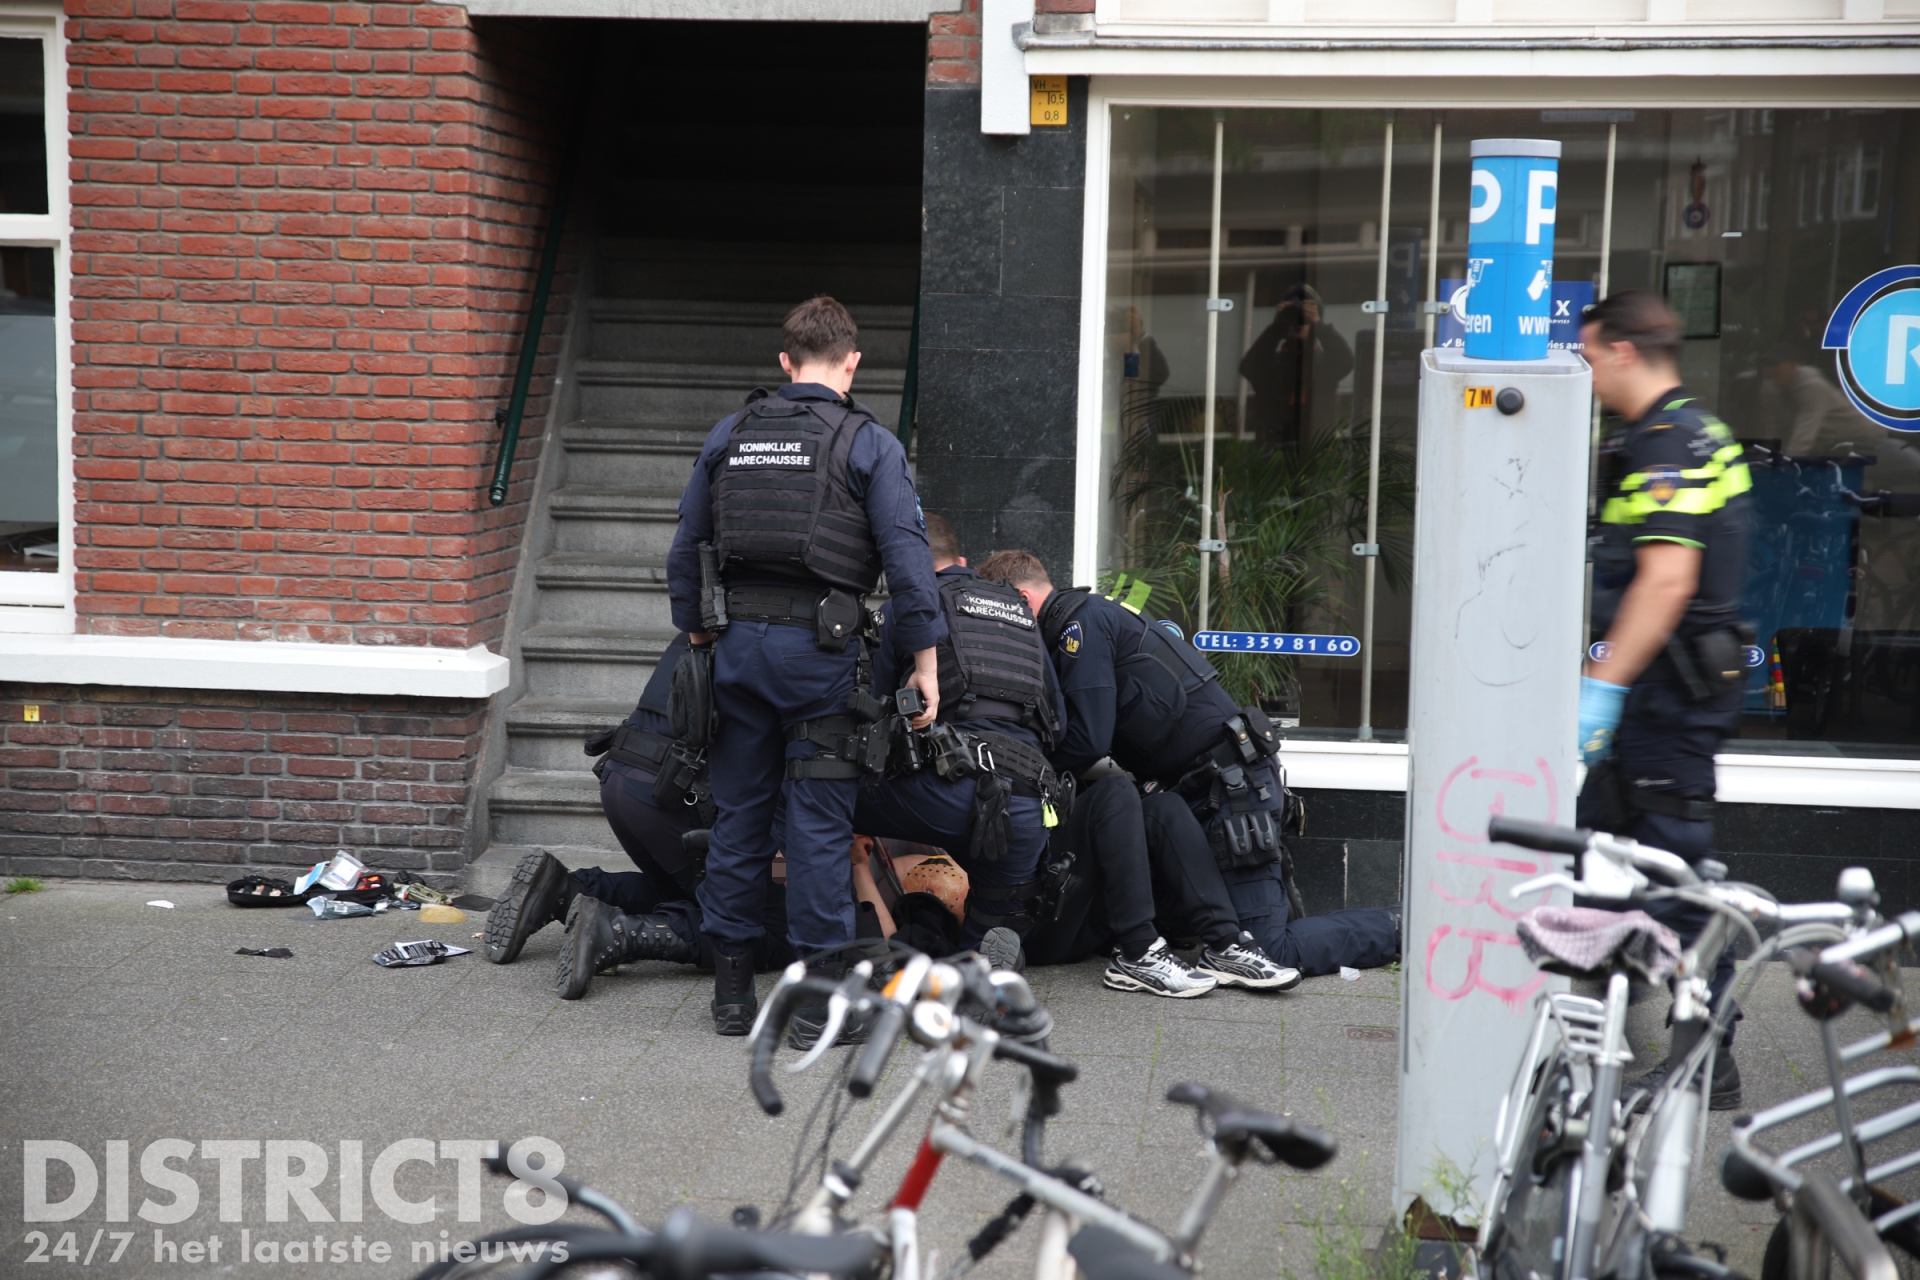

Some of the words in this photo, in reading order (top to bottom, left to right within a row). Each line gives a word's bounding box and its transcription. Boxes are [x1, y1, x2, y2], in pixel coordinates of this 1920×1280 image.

[1525, 169, 1558, 245] P
[1468, 388, 1477, 407] 7
[1481, 389, 1492, 404] M
[739, 442, 802, 453] KONINKLIJKE
[729, 455, 811, 466] MARECHAUSSEE
[1198, 634, 1237, 648] TEL:
[1246, 635, 1284, 650] 359
[1293, 637, 1316, 650] 81
[1327, 639, 1353, 652] 60
